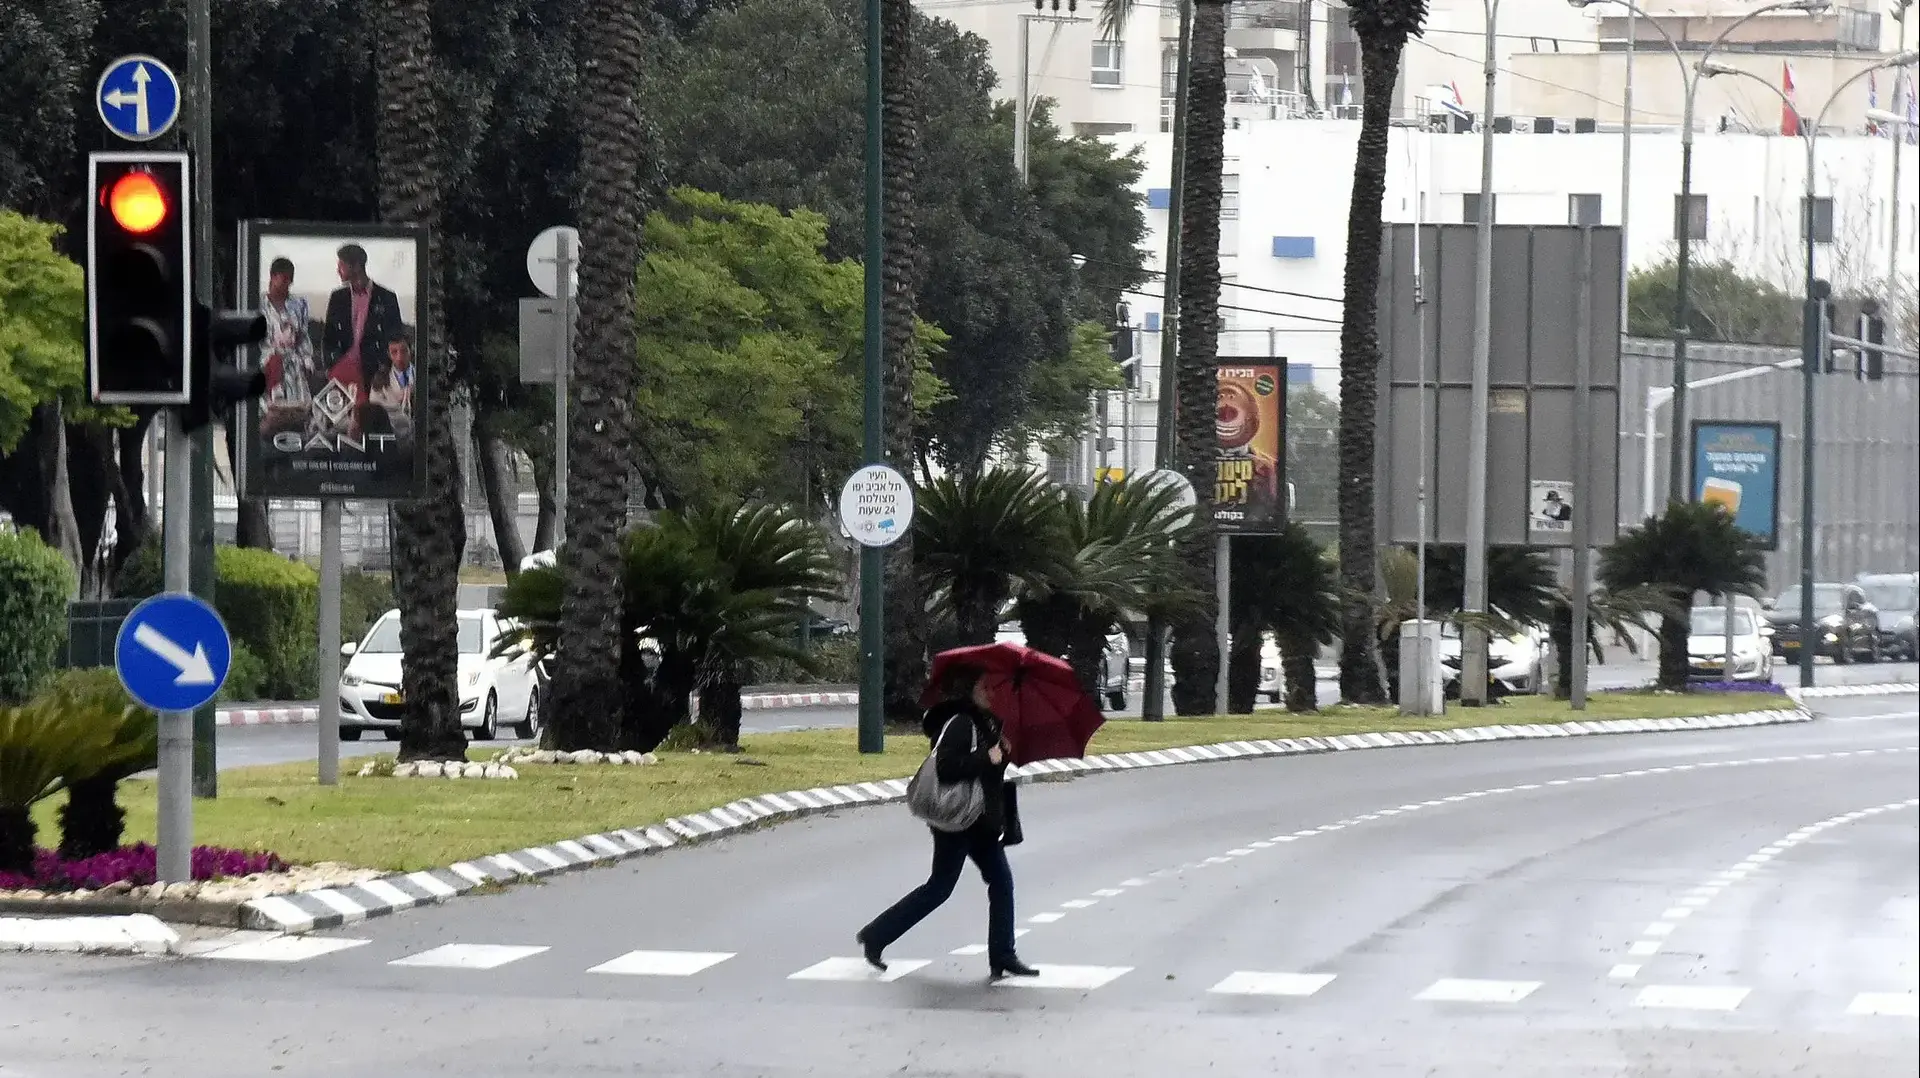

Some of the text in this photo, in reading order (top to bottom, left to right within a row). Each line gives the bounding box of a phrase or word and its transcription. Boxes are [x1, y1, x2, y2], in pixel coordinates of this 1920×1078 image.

[273, 431, 397, 453] GANT
[866, 471, 888, 480] העיר
[852, 480, 902, 492] תל אביב יפו
[858, 493, 896, 503] מצולמת
[858, 505, 896, 515] 24 שעות
